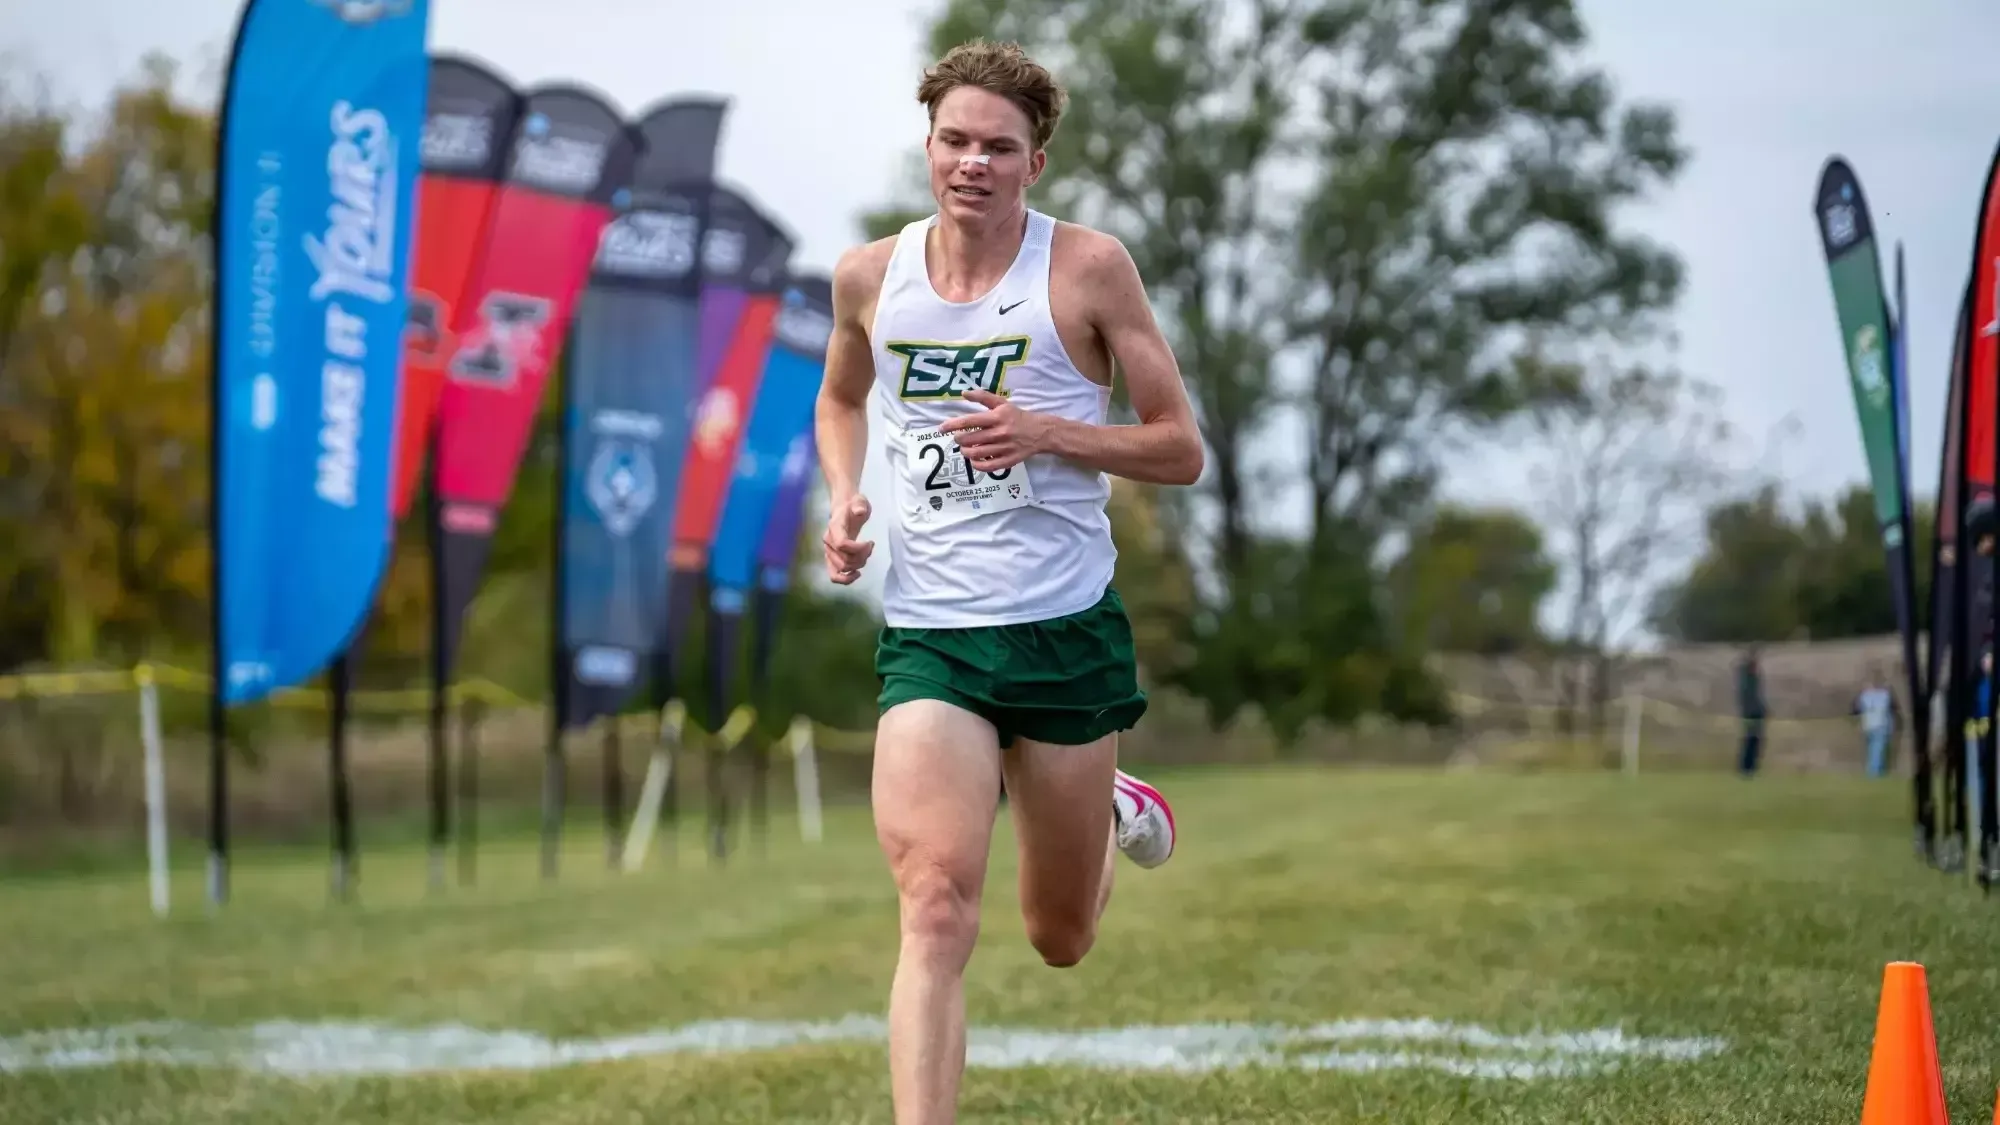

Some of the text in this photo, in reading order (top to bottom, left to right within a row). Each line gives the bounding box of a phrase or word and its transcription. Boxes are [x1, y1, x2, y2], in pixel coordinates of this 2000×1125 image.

[302, 100, 398, 508] MAKE IT YOURS
[906, 343, 1018, 392] S&T
[917, 433, 932, 442] 2025
[946, 489, 974, 498] OCTOBER
[985, 484, 1001, 492] 2025
